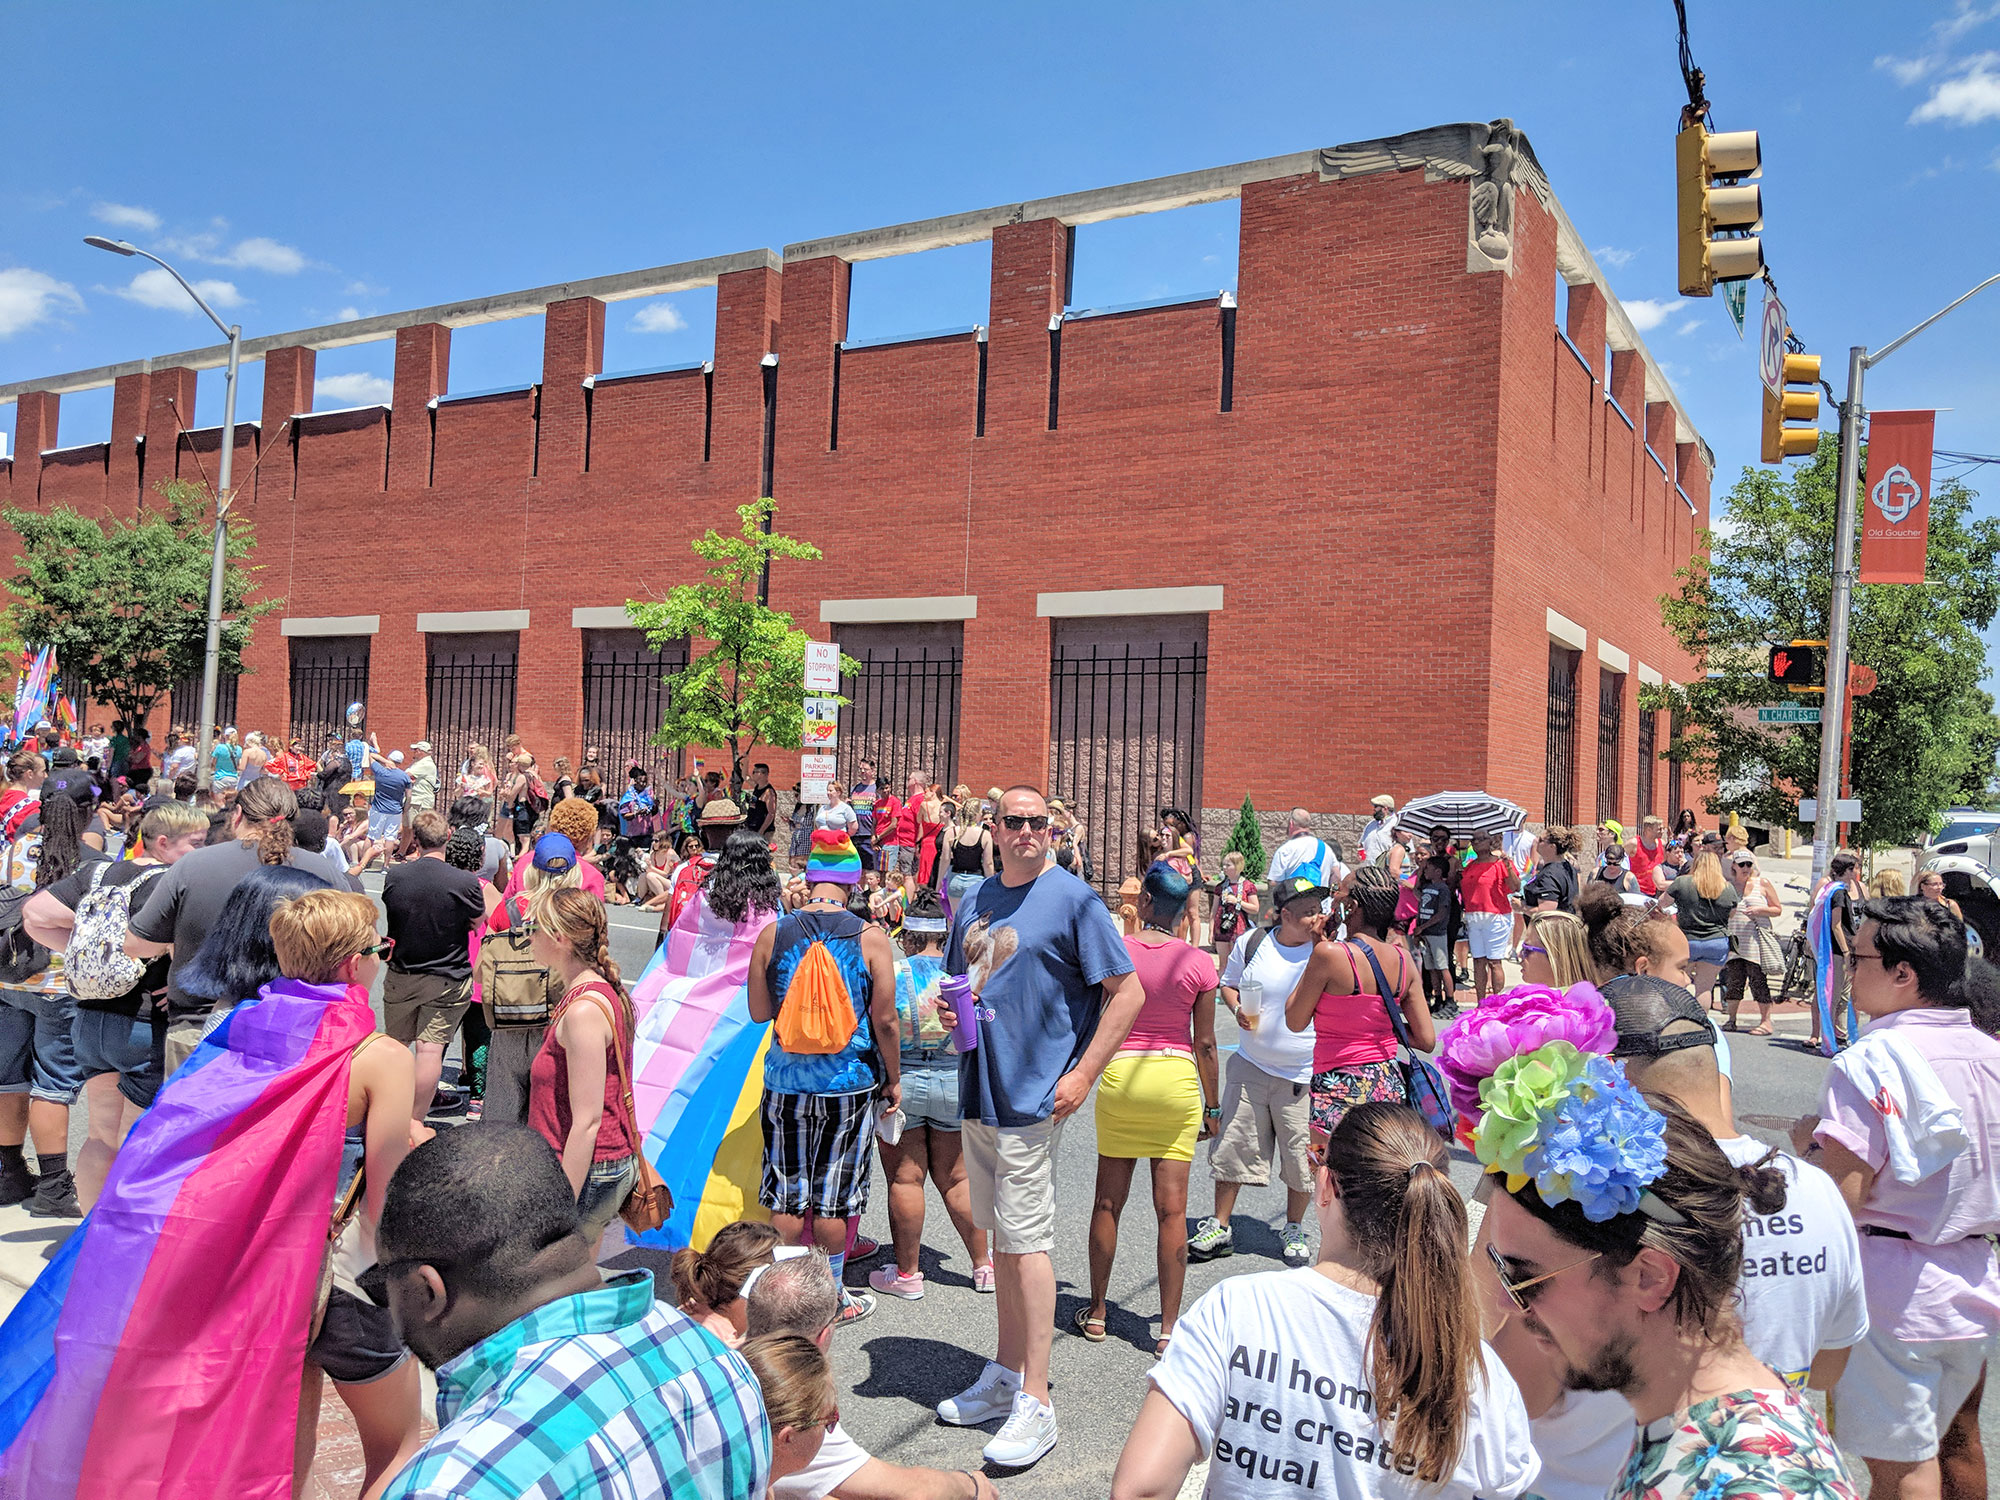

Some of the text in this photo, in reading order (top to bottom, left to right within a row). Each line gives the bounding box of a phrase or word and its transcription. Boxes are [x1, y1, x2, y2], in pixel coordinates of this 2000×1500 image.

[1867, 528, 1922, 536] Old Goucher
[817, 648, 828, 658] NO
[809, 662, 836, 673] STOPPING
[1771, 710, 1808, 721] CHARLES
[1740, 1213, 1804, 1237] mes
[1741, 1246, 1827, 1278] eated
[1229, 1344, 1279, 1384] All
[1225, 1395, 1283, 1434] are
[1215, 1438, 1320, 1490] equal
